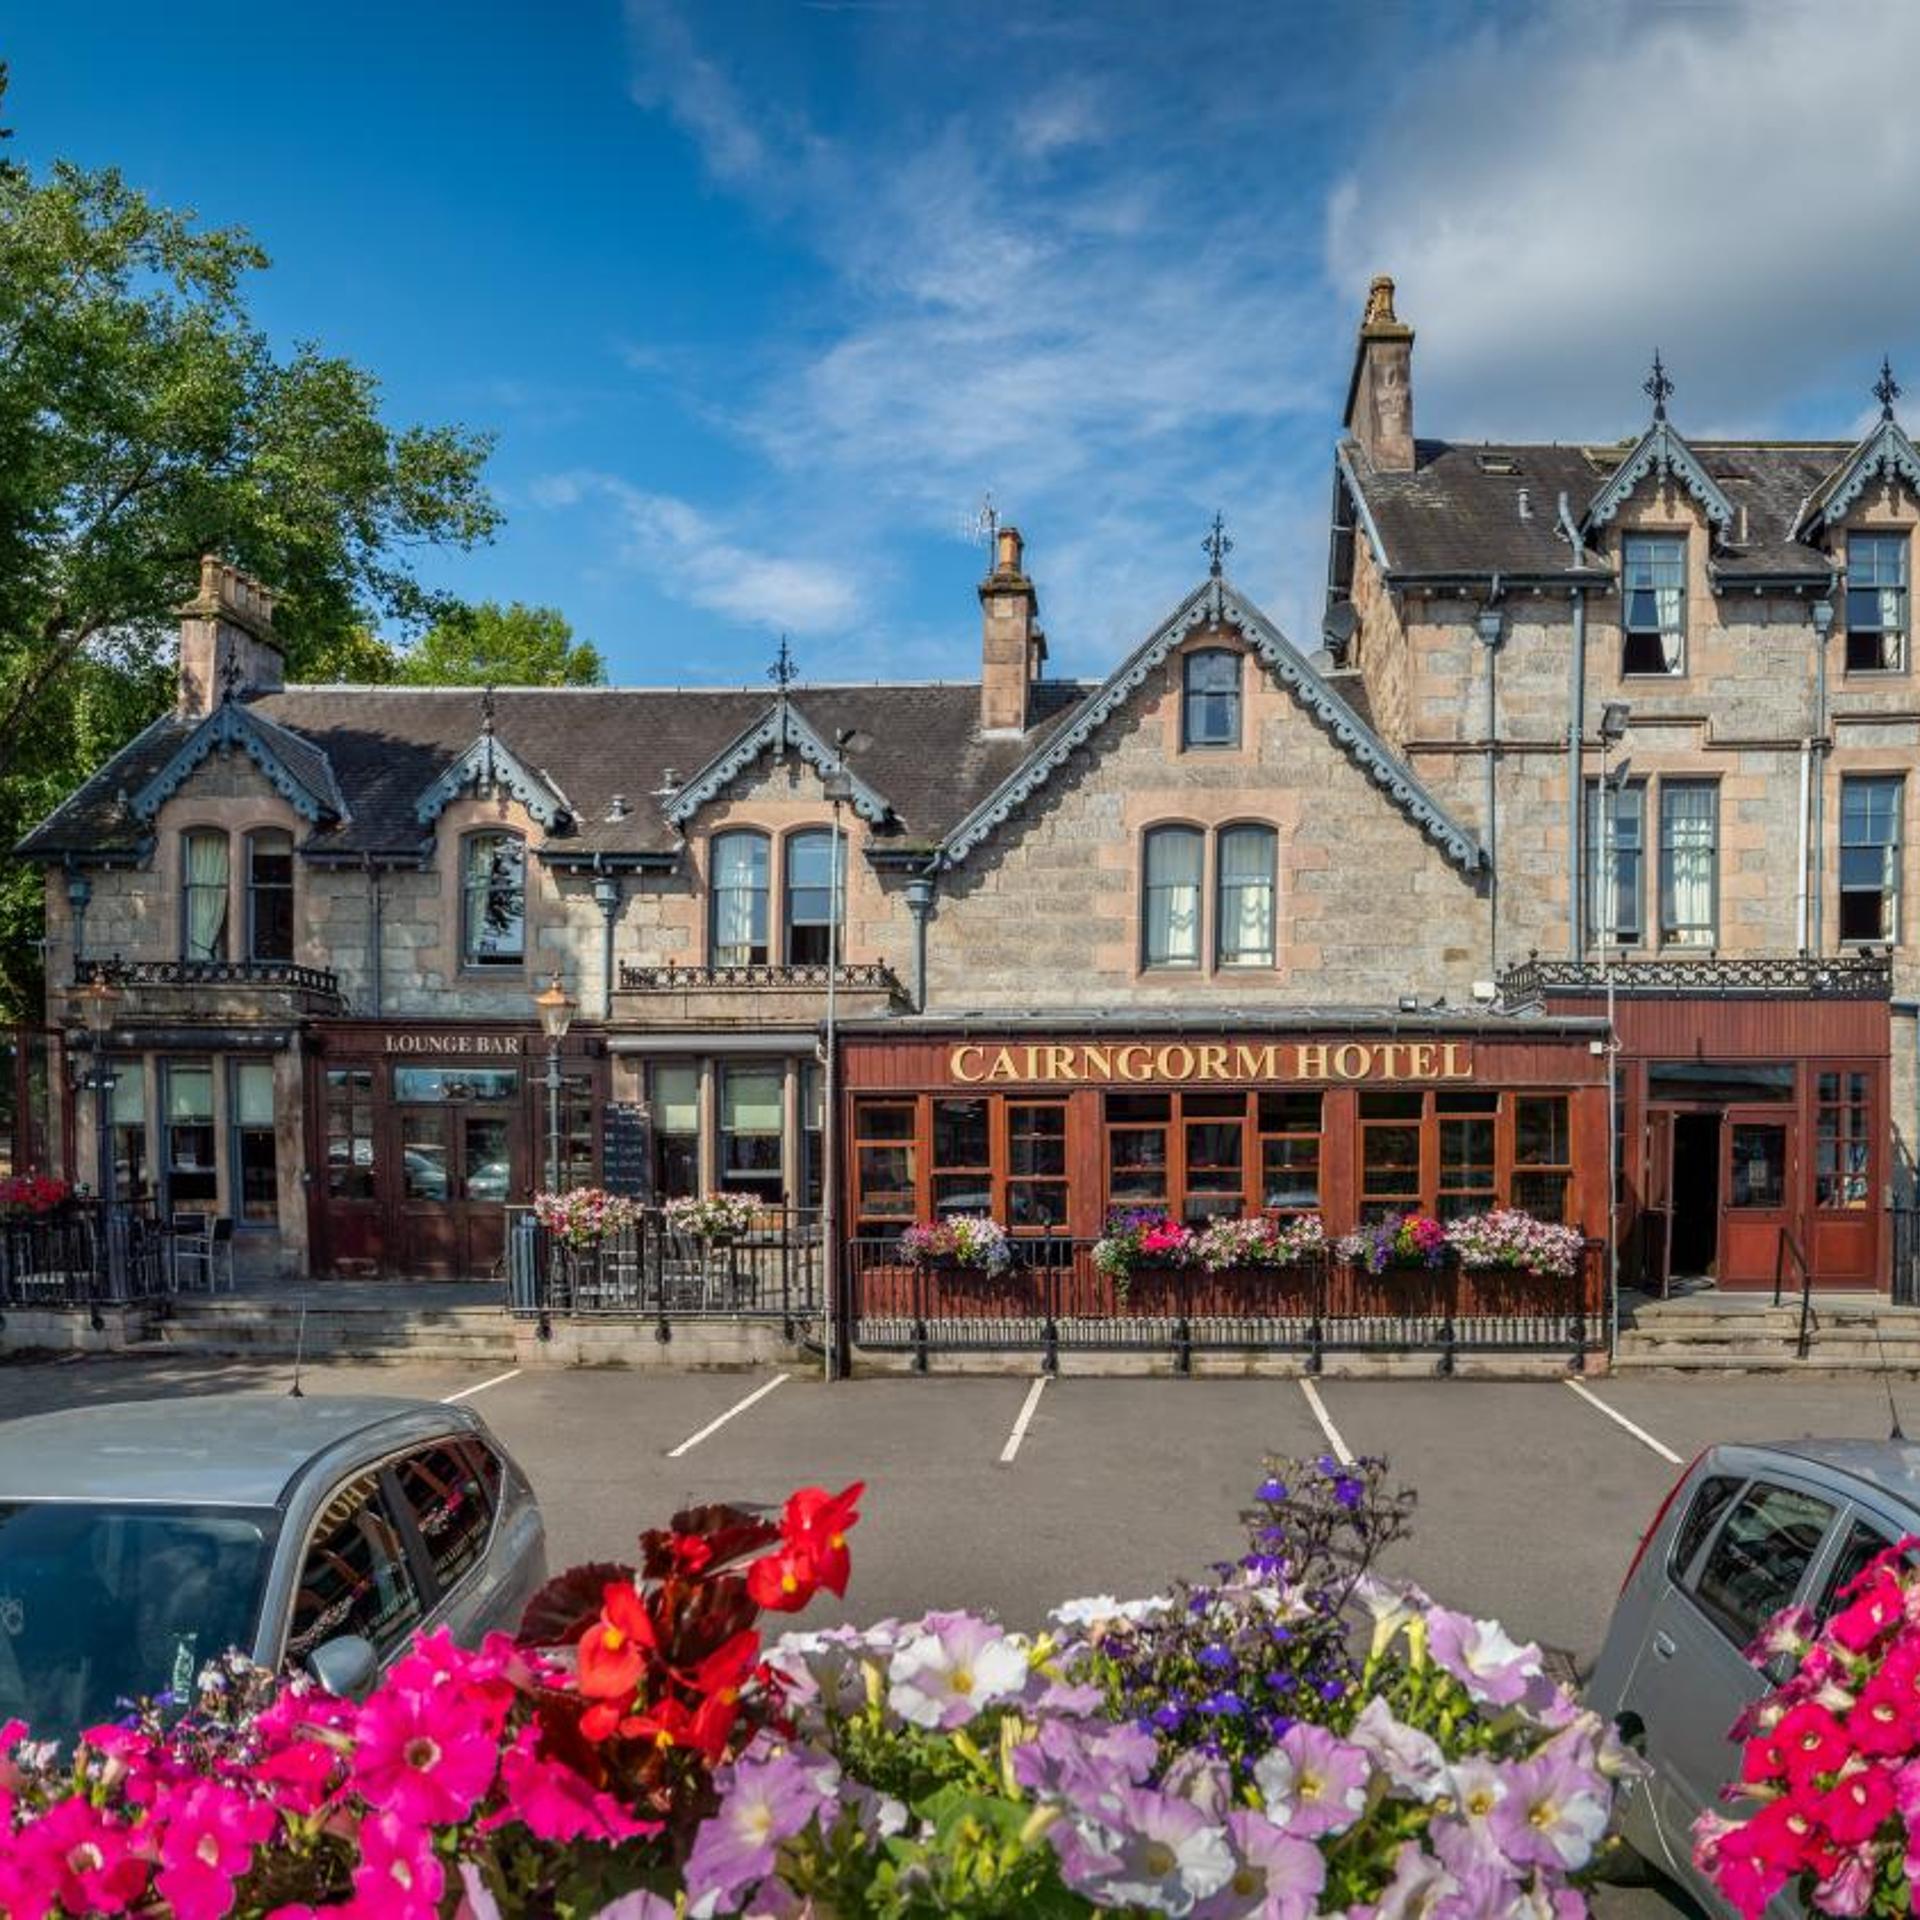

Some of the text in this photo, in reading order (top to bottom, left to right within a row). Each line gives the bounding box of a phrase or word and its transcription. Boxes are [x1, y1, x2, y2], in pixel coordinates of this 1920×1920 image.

[384, 1034, 519, 1053] LOUNGE BAR
[950, 1043, 1473, 1082] CAIRNGORM HOTEL
